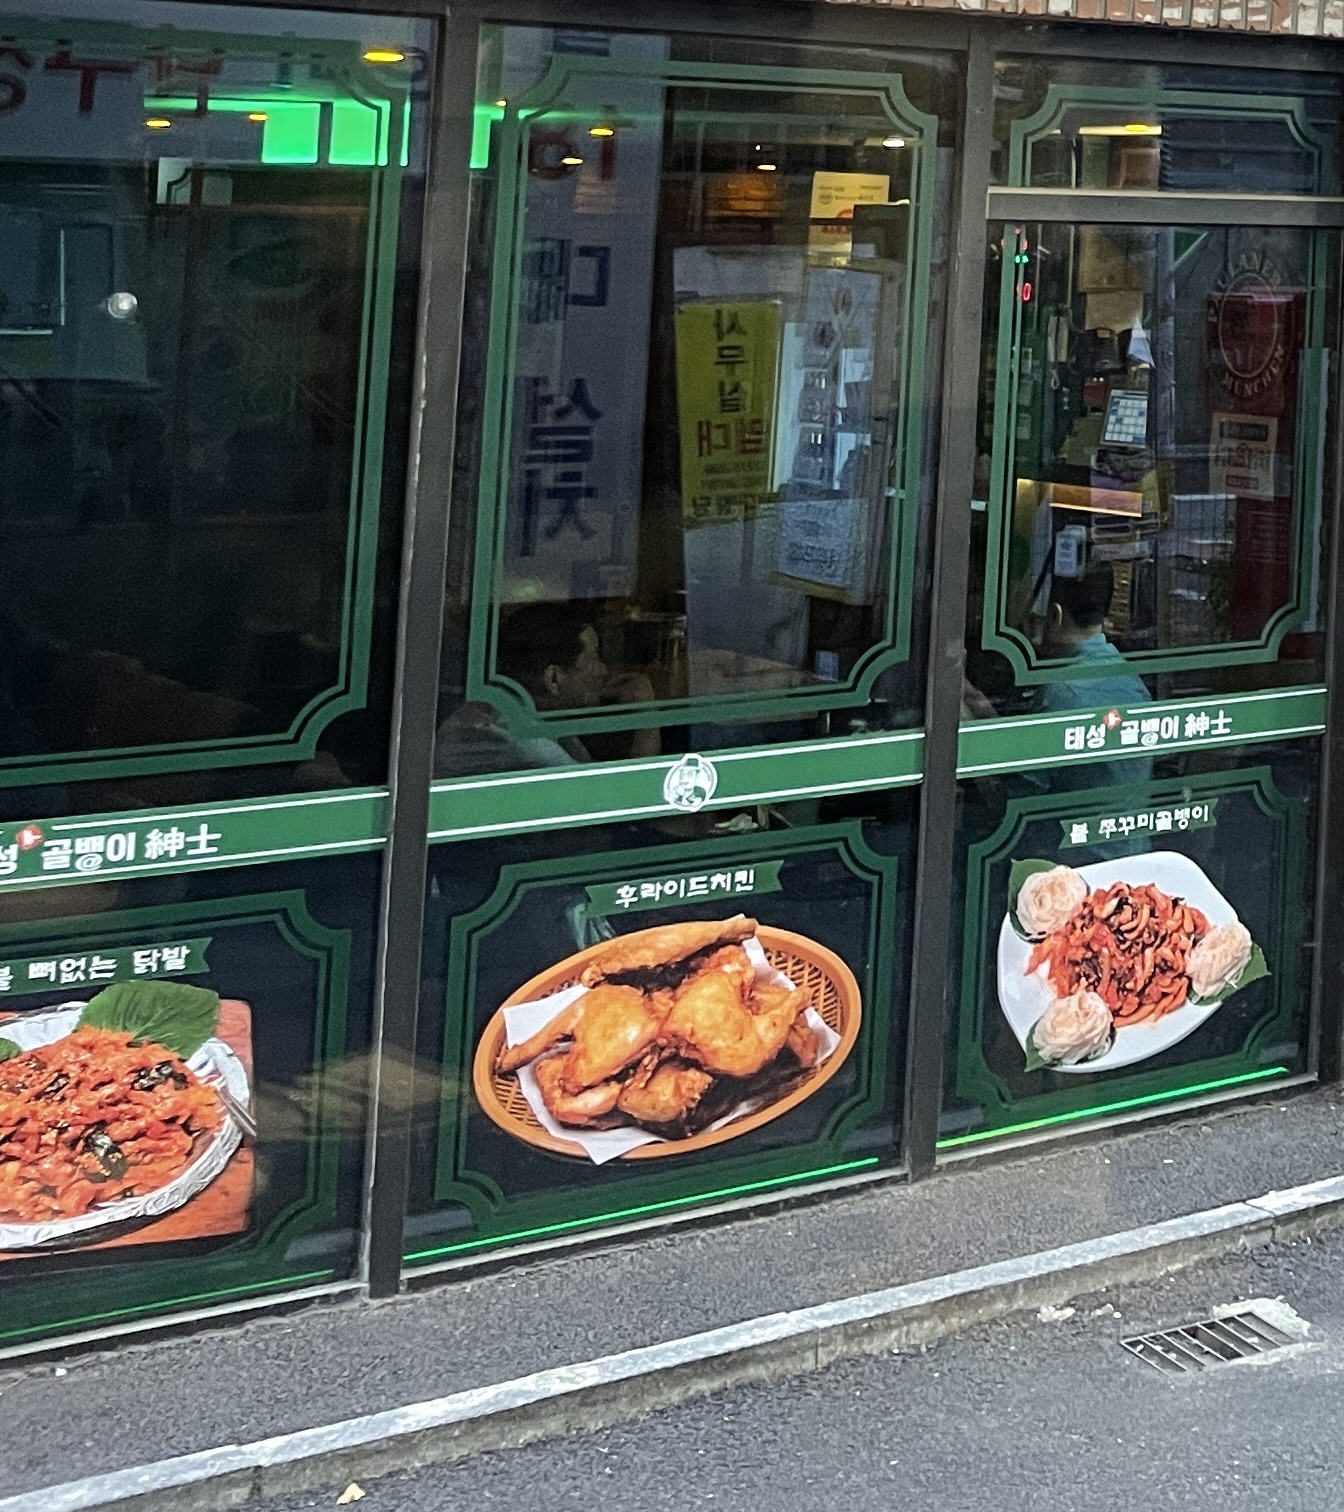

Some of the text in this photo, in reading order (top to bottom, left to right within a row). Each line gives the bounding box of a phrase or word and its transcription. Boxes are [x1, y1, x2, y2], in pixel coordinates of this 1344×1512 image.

[1064, 724, 1107, 750] 태성
[1184, 709, 1233, 738] 紳士
[1098, 804, 1209, 839] 쭈꾸미골뱅이
[144, 823, 222, 860] 紳士
[615, 868, 755, 909] 후라이드치킨
[132, 945, 191, 975] 닭발
